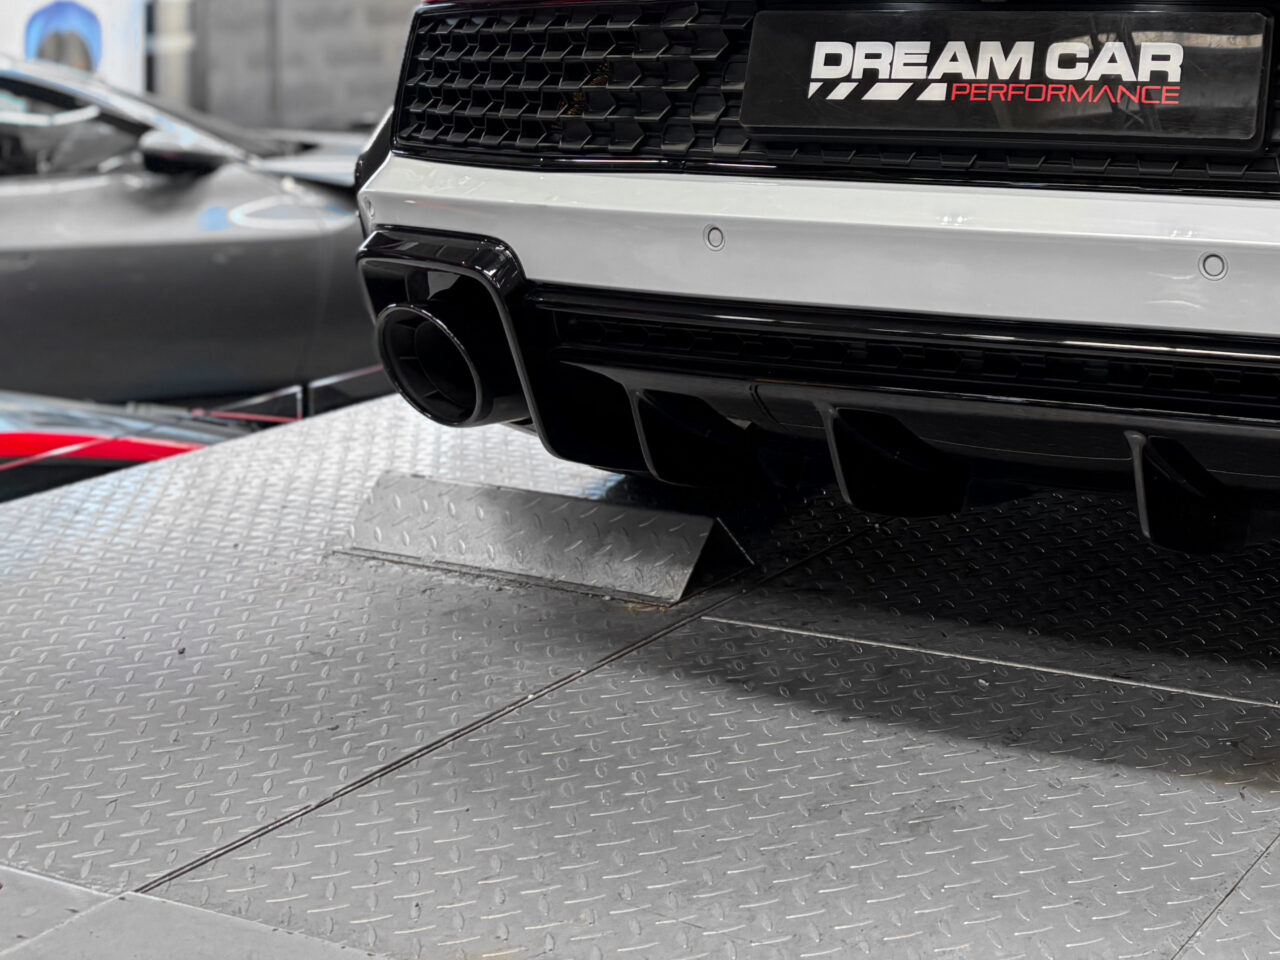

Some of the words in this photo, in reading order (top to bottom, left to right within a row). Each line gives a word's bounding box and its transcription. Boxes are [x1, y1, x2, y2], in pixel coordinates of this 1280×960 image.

[810, 40, 1035, 80] DREAM
[1045, 41, 1184, 82] CAR
[950, 82, 1181, 105] PERFORMANCE
